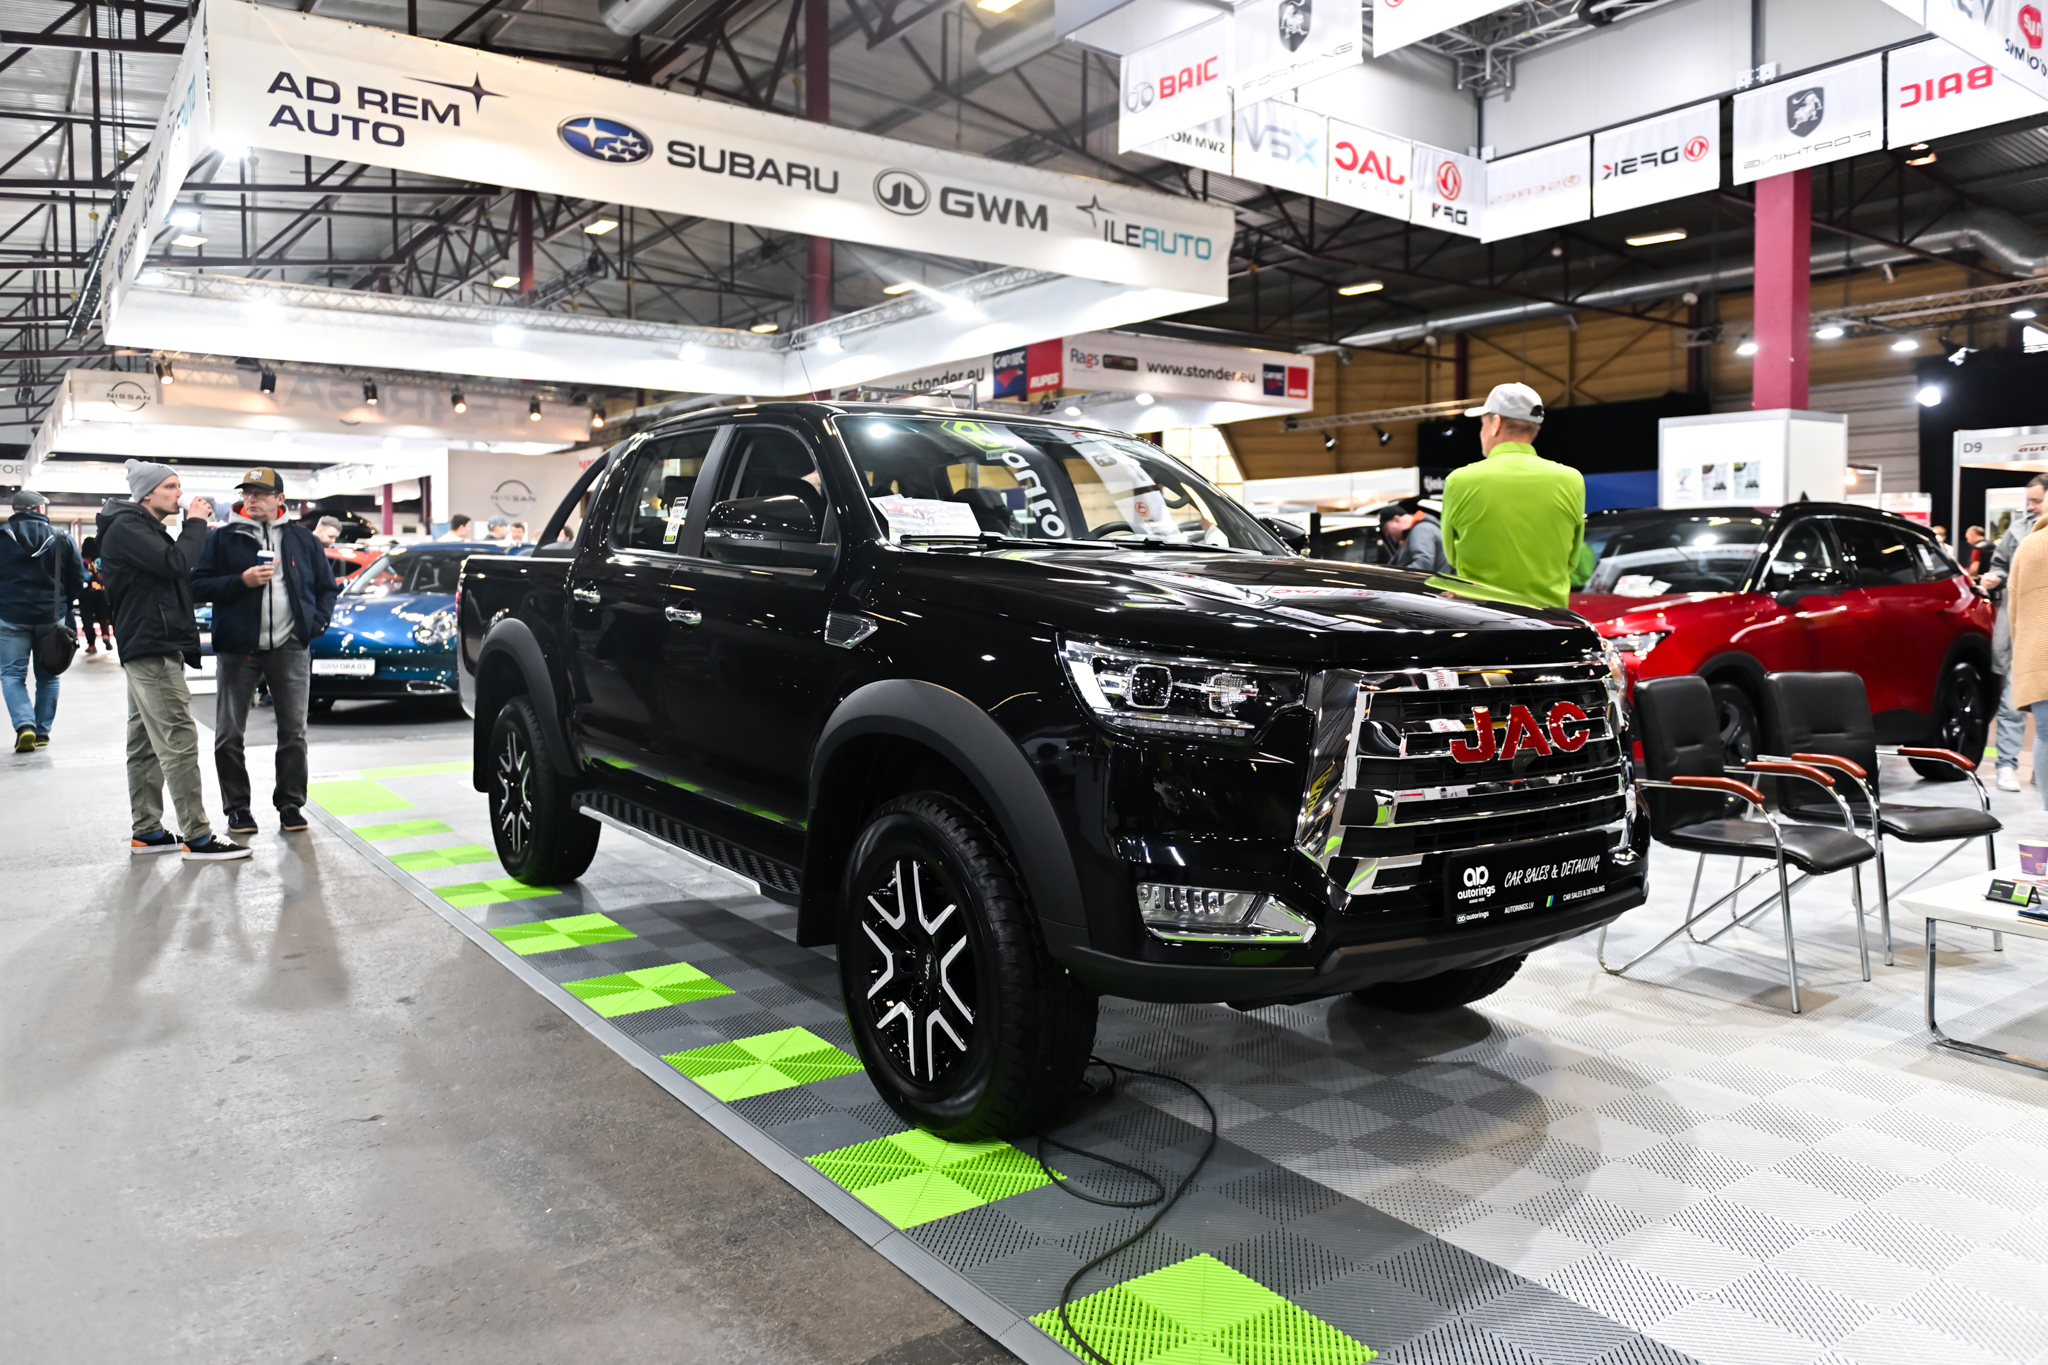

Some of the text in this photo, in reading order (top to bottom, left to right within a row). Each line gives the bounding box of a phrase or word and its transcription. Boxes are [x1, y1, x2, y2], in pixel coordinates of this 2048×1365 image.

[1159, 55, 1218, 100] BAIC
[267, 71, 461, 127] AD REM
[268, 104, 405, 148] AUTO
[667, 140, 840, 194] SUBARU
[940, 187, 1049, 232] GWM
[1104, 219, 1211, 260] ILEAUTO
[1070, 348, 1099, 369] Rags
[1147, 361, 1256, 383] www.stonder.eu
[106, 391, 151, 401] NISSAN
[1030, 372, 1060, 389] RUPES
[1963, 442, 1982, 453] D9
[1449, 701, 1590, 764] JAC
[1504, 855, 1600, 888] CAR SALES & DETAILING
[1457, 885, 1496, 900] autorings
[1571, 890, 1583, 899] SALES
[1586, 885, 1605, 896] DETAILING
